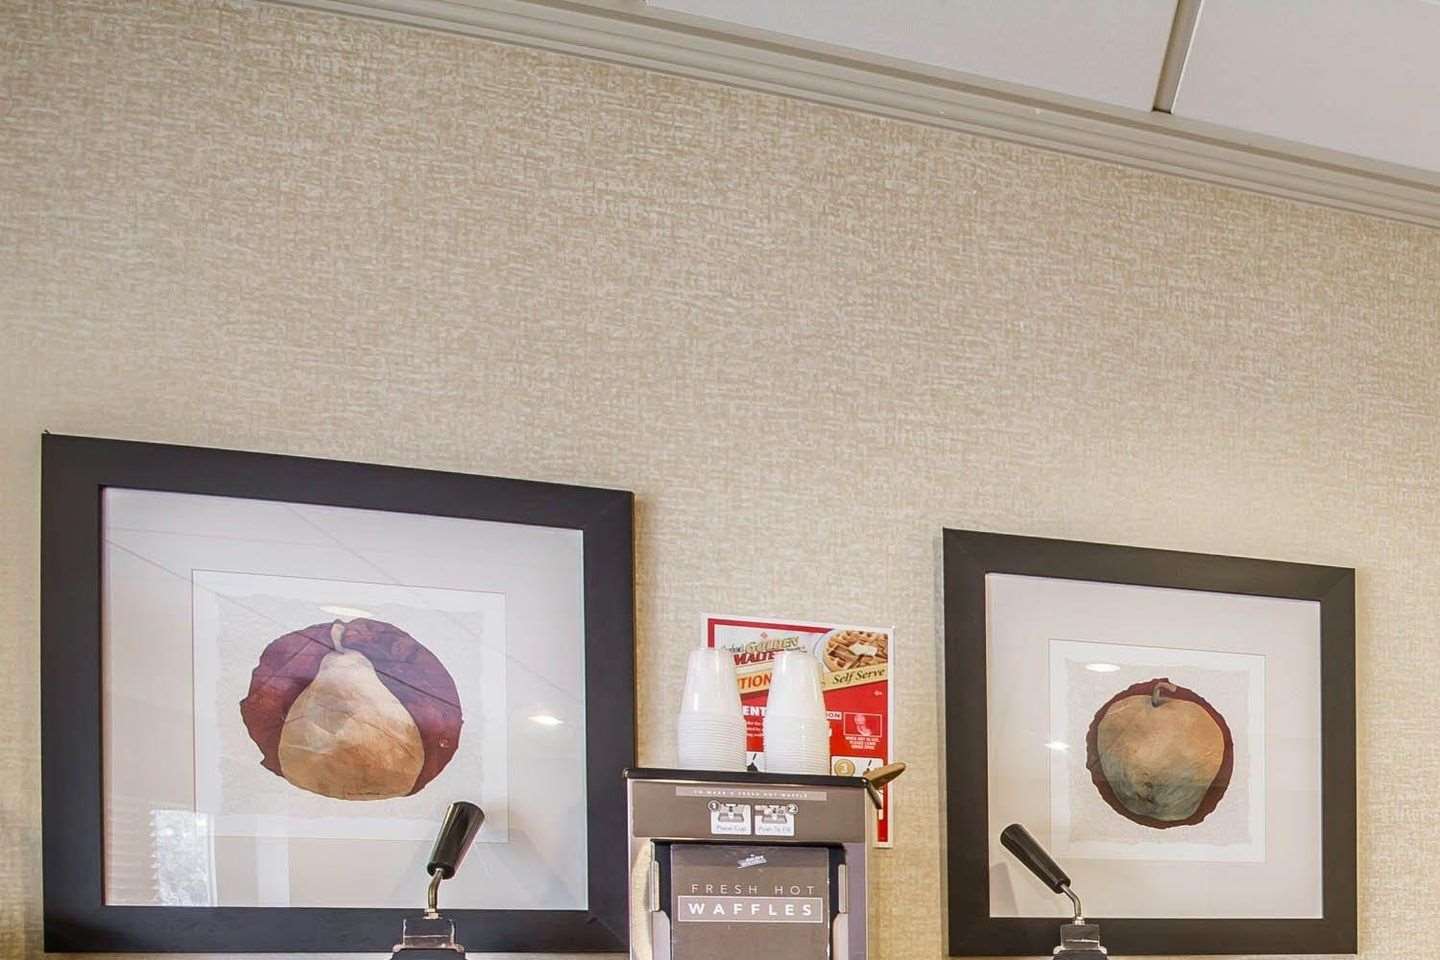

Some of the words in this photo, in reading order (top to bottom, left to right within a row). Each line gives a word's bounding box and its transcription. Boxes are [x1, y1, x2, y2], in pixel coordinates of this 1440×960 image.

[832, 671, 853, 685] Self
[855, 668, 886, 681] Serve
[691, 884, 758, 895] FRESH
[774, 885, 816, 895] HOT
[688, 903, 812, 916] WAFFLES
